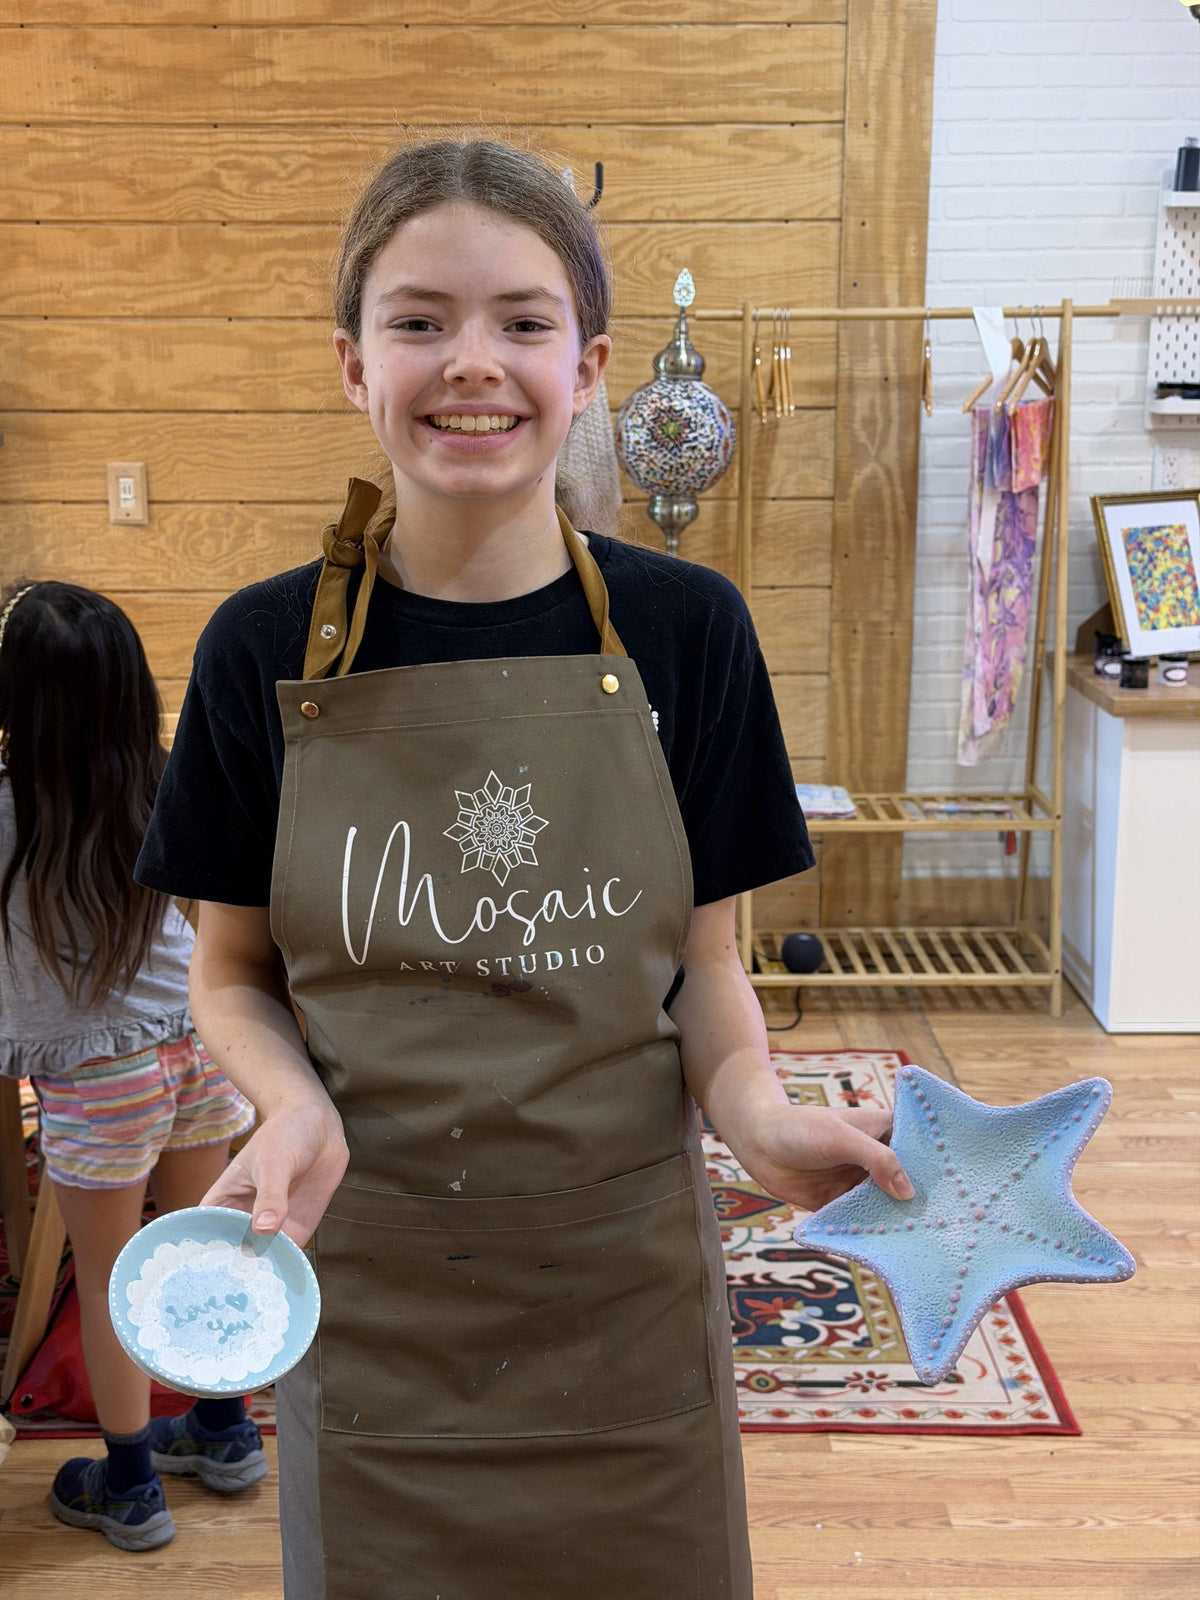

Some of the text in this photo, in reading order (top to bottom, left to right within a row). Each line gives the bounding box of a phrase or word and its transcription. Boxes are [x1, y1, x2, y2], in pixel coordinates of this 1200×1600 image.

[341, 820, 643, 966] Mosaic
[399, 944, 606, 977] ART STUDIO
